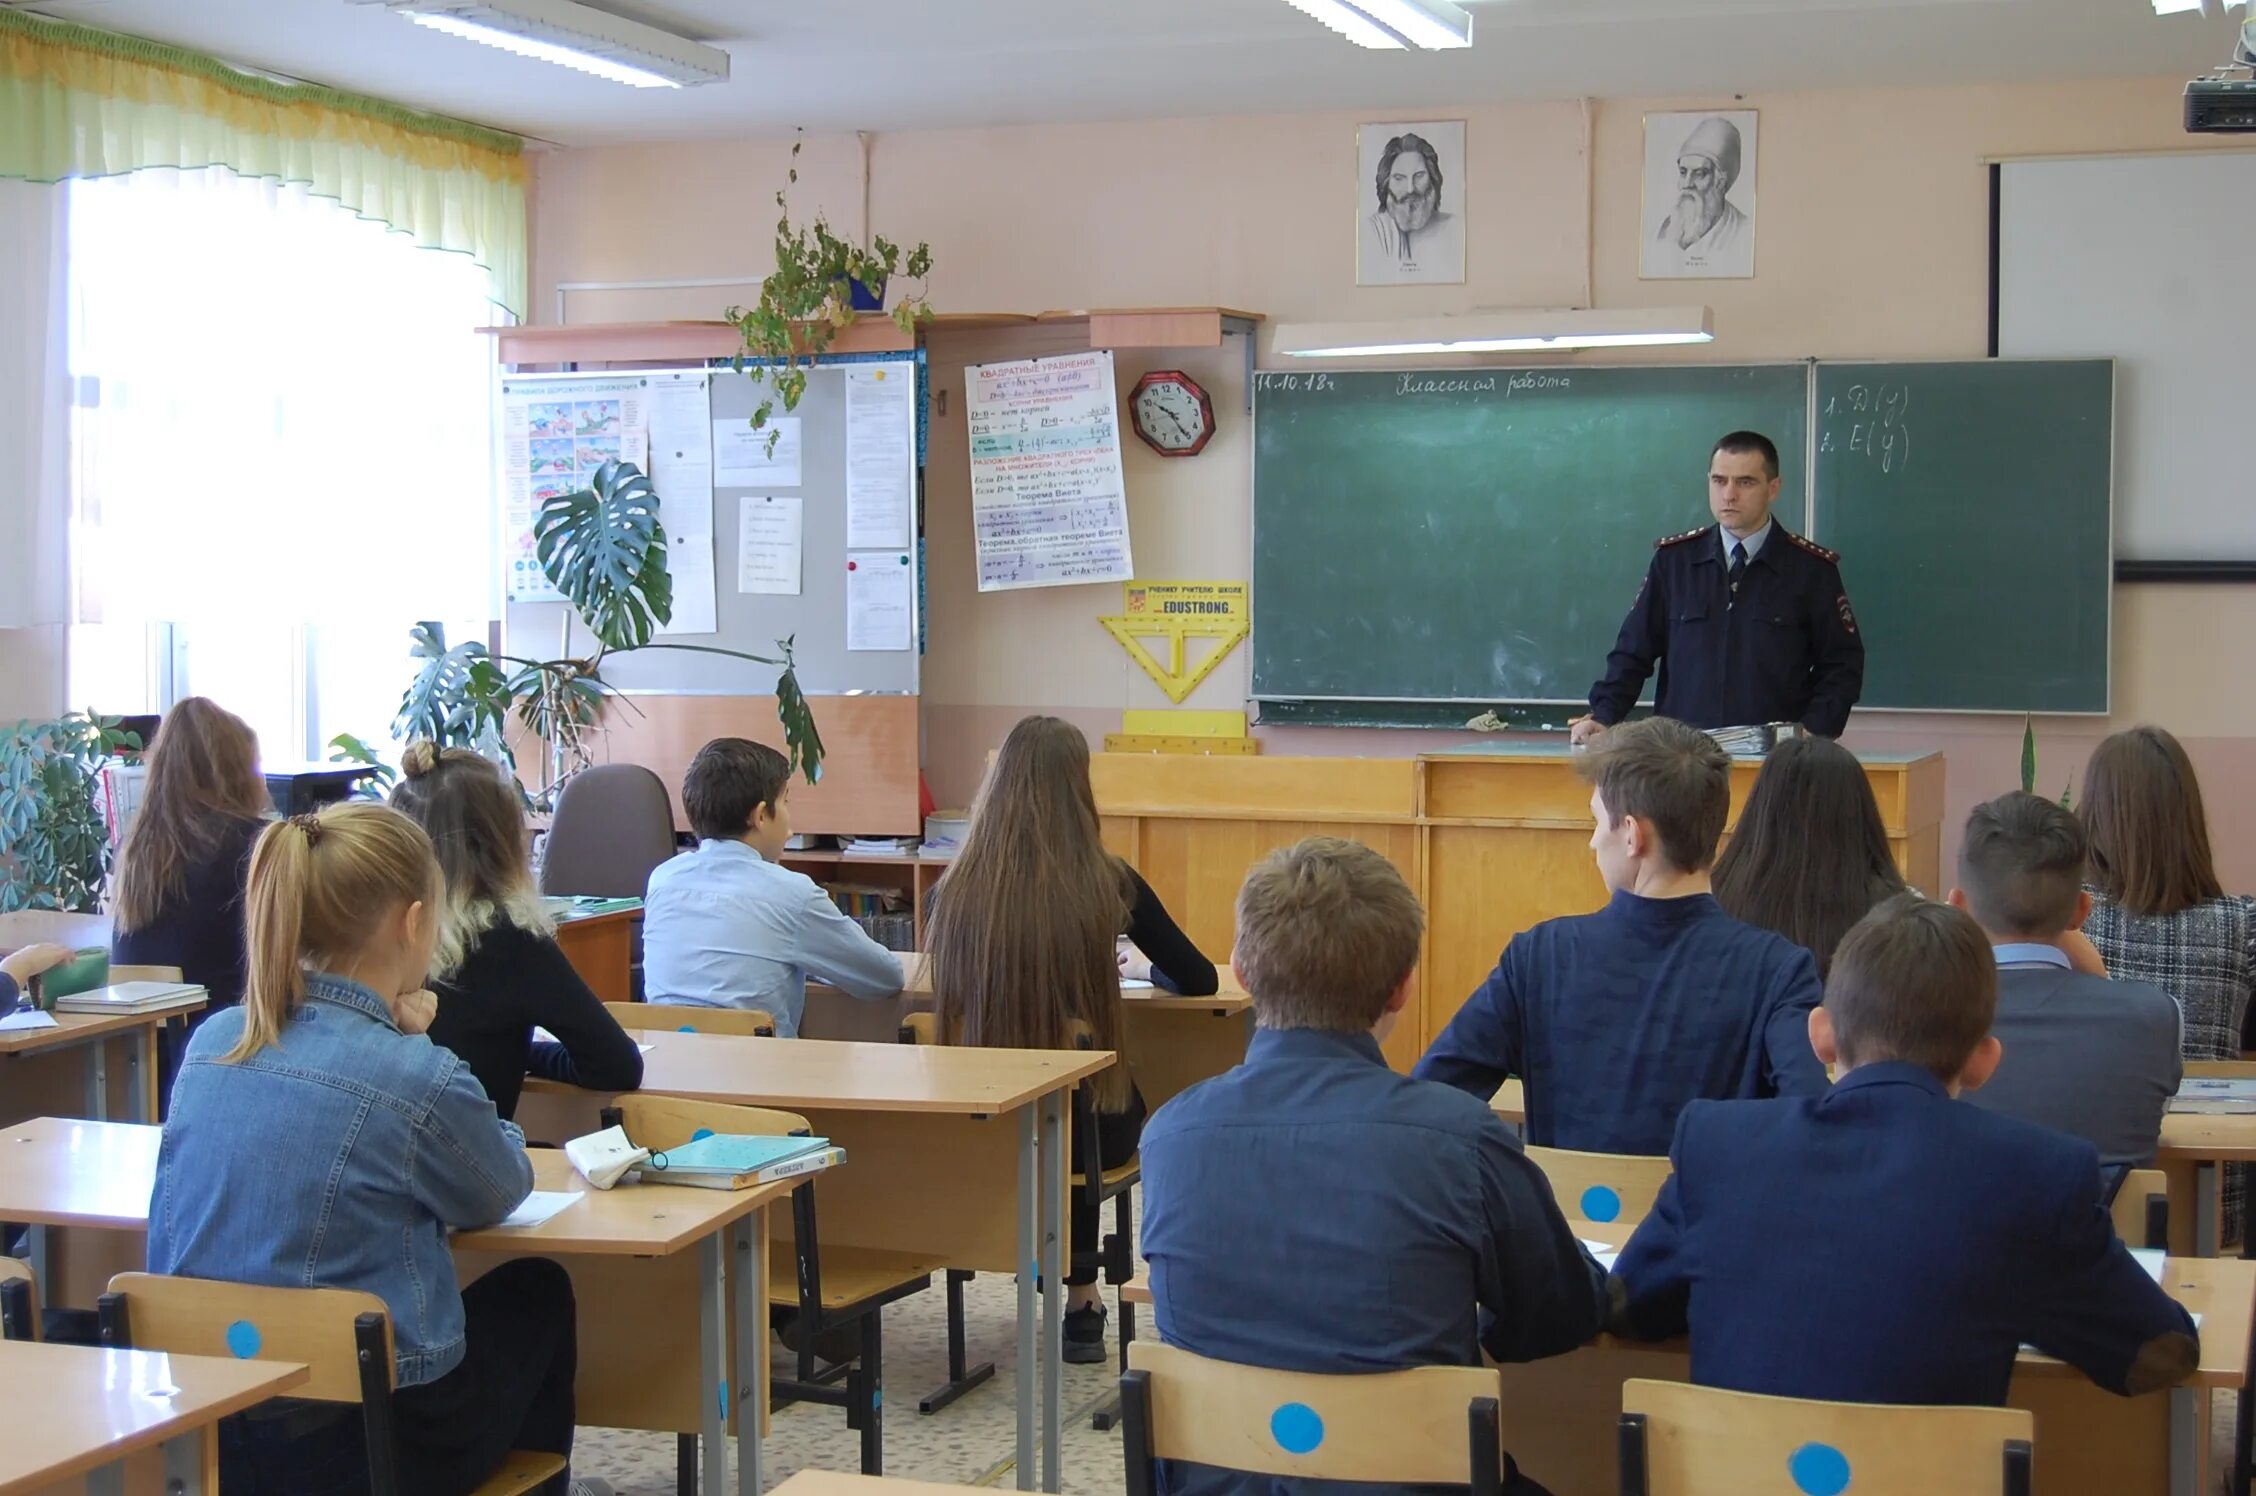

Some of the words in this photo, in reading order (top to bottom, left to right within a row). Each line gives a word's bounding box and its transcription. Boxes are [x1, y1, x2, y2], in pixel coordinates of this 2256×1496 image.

[980, 366, 1040, 378] КВАДРАТНЫЕ
[1042, 358, 1096, 372] УРАВНЕНИЯ
[1161, 384, 1171, 393] 12
[1396, 373, 1496, 396] Классная
[1506, 371, 1572, 398] работа
[1151, 388, 1159, 396] 11
[1176, 386, 1182, 394] 1
[1143, 398, 1153, 407] 10
[1186, 396, 1192, 404] 2
[1144, 411, 1150, 419] 9
[1192, 408, 1199, 417] 3
[1150, 424, 1157, 433] 8
[1192, 421, 1198, 430] 4
[1162, 432, 1167, 441] 7
[1174, 434, 1181, 443] 6
[1016, 491, 1053, 501] Теорема
[1055, 488, 1081, 497] Виета
[1163, 601, 1229, 614] EDUSTRONG
